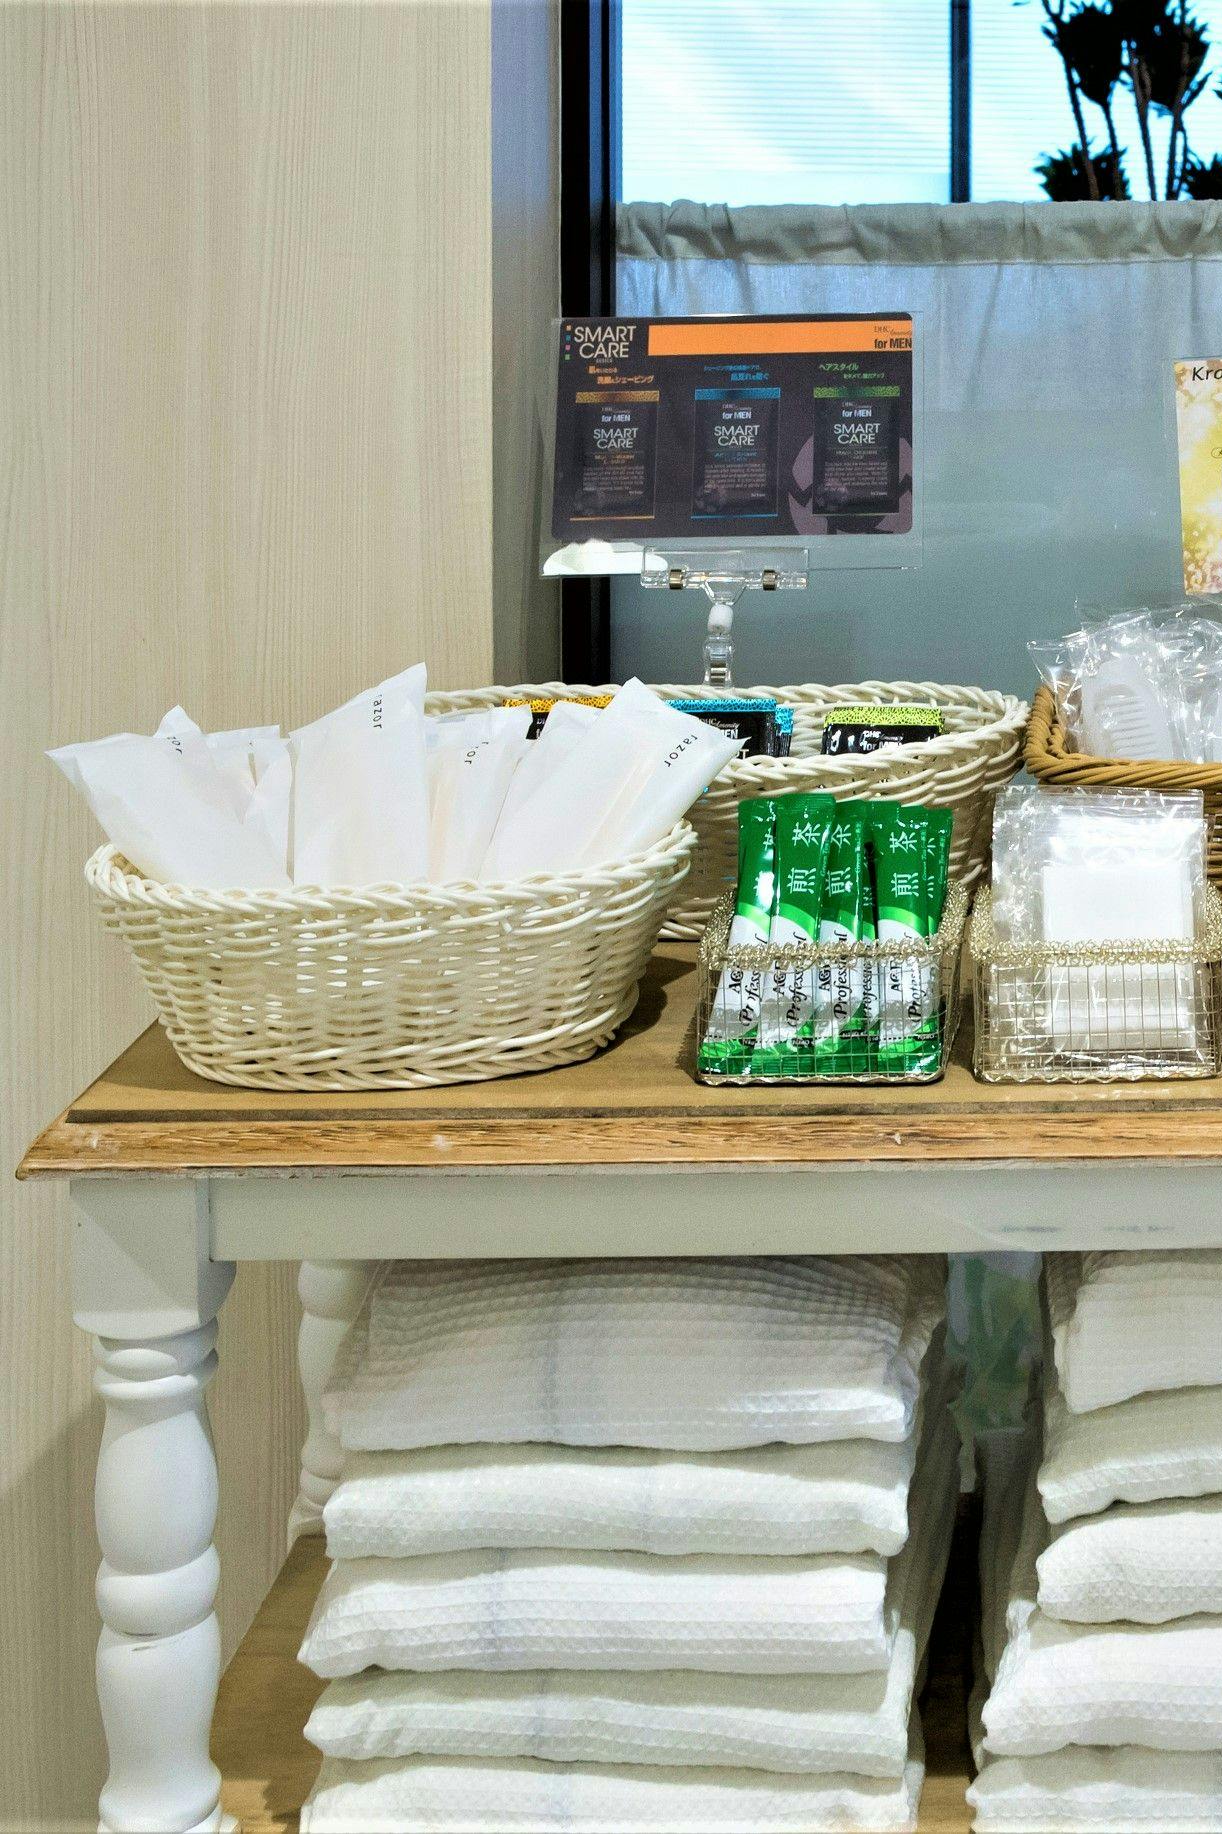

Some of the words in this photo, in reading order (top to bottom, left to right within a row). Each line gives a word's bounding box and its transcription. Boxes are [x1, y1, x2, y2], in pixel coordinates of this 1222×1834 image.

[574, 326, 636, 342] SMART
[874, 338, 888, 349] for
[890, 337, 912, 349] MEN
[579, 342, 629, 359] CARE
[613, 414, 631, 422] MEN
[722, 412, 733, 420] for
[734, 411, 752, 419] MEN
[842, 409, 853, 417] for
[854, 409, 872, 417] MEN
[593, 427, 639, 440] SMART
[714, 425, 760, 436] SMART
[834, 423, 881, 434] SMART
[597, 438, 634, 449] CARE
[718, 436, 755, 446] CARE
[838, 433, 876, 444] CARE
[464, 741, 489, 765] ror
[664, 734, 698, 768] razor
[787, 822, 821, 895] 煎茶
[890, 831, 919, 898] 煎茶
[728, 964, 744, 995] AG
